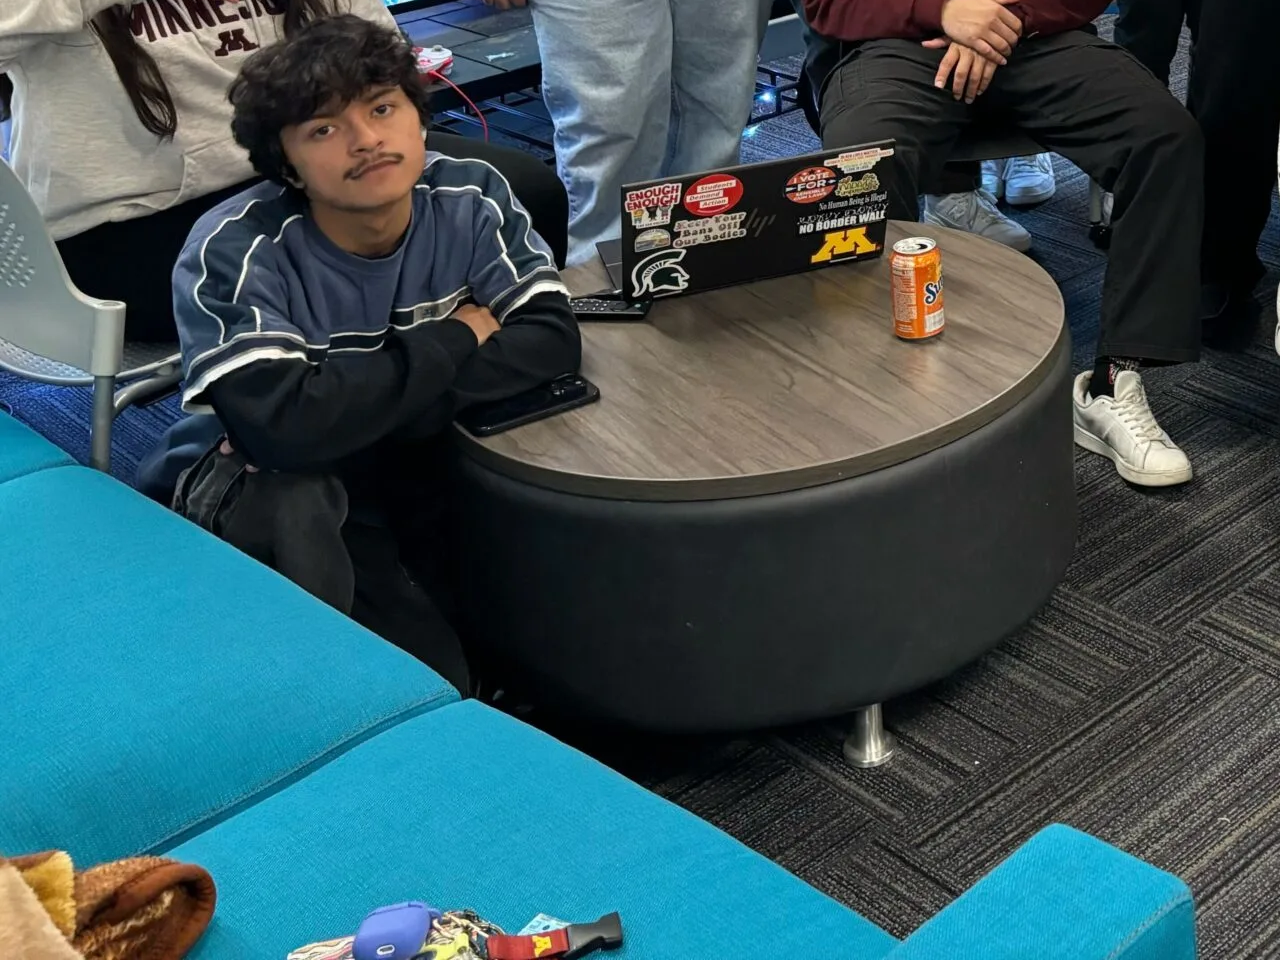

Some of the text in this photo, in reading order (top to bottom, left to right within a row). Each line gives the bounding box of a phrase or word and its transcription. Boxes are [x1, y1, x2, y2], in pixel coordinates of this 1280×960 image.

[800, 172, 830, 182] VOTE
[628, 184, 680, 202] ENOUGH
[701, 182, 733, 191] Students
[797, 180, 827, 191] FOR
[626, 194, 678, 211] ENOUGH
[689, 192, 721, 201] Demand
[702, 199, 727, 207] Action
[819, 202, 828, 211] No
[828, 200, 848, 210] Human
[849, 197, 865, 206] Being
[870, 191, 888, 202] Illegal
[677, 220, 710, 229] Keep
[714, 213, 744, 223] Your
[682, 221, 739, 237] Bans Off
[799, 223, 814, 235] NO
[815, 215, 857, 232] BORDER
[859, 210, 886, 223] WALL
[675, 230, 744, 247] Our Bodies
